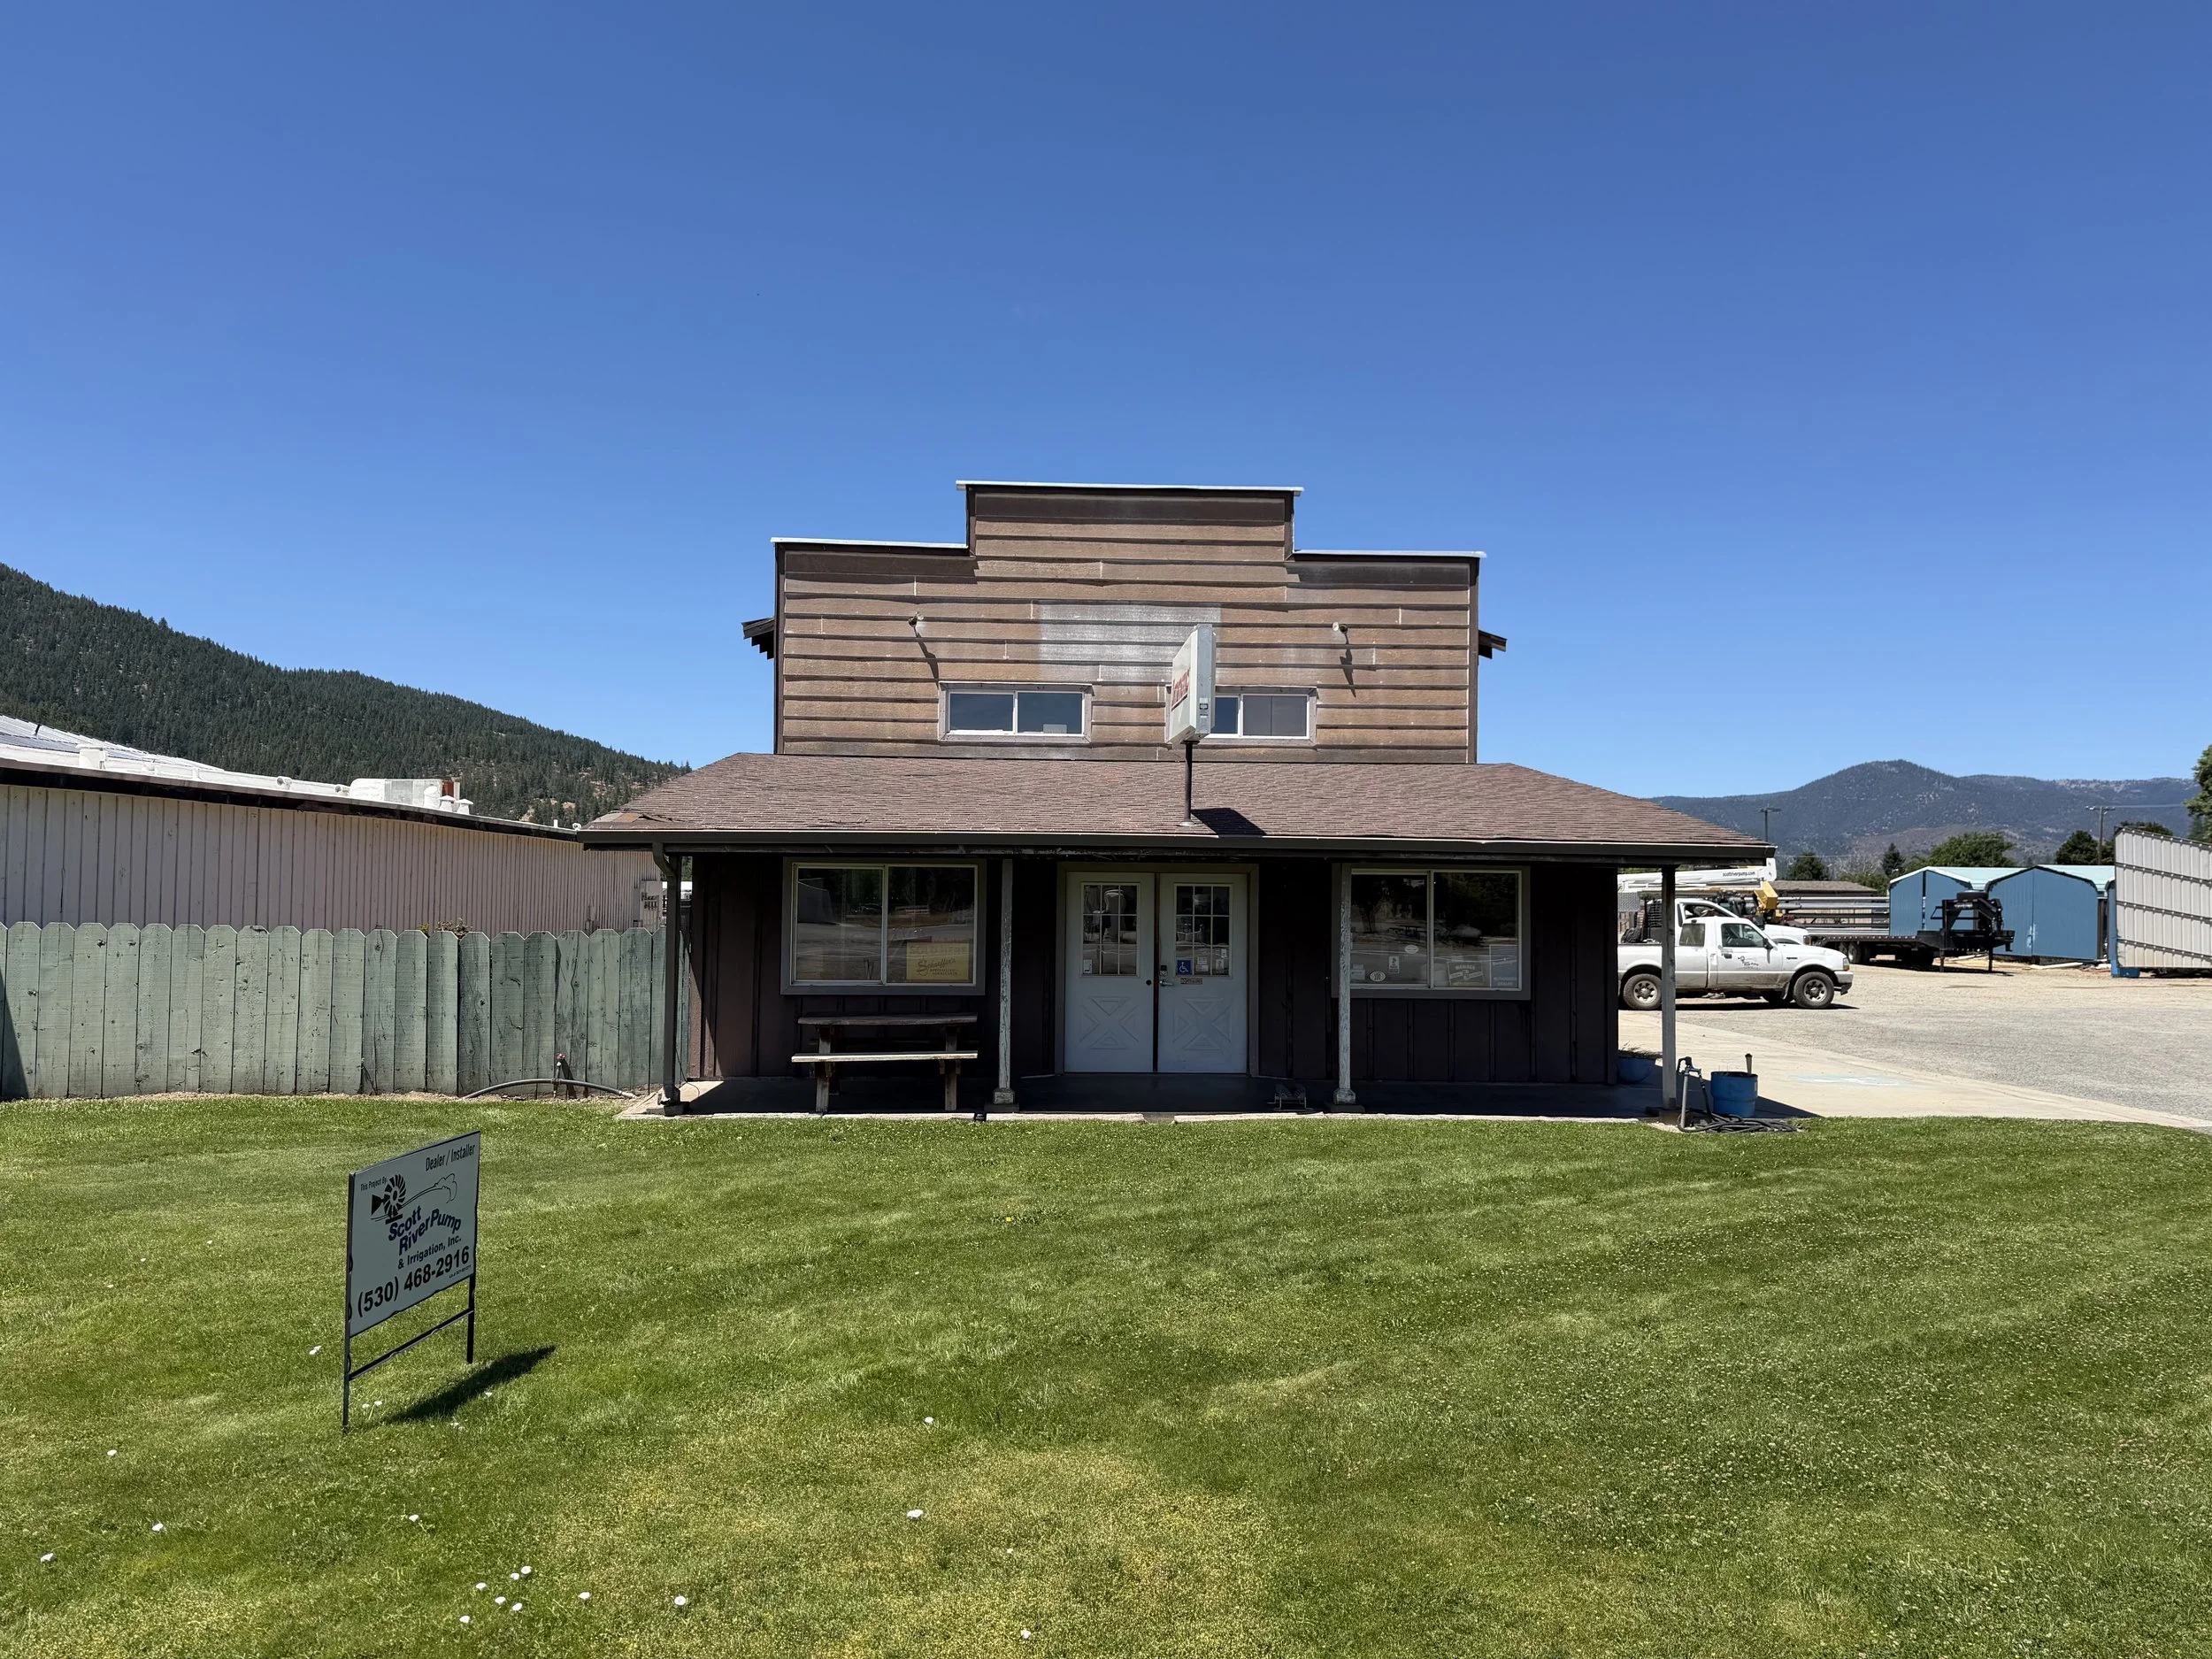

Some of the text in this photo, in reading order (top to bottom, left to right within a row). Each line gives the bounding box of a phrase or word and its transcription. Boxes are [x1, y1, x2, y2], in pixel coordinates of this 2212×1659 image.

[426, 1154, 445, 1171] Dealer
[451, 1144, 475, 1163] Installer
[369, 1178, 381, 1189] Project
[388, 1205, 421, 1241] Scott
[399, 1209, 461, 1256] River Pump
[398, 1235, 461, 1270] & Irrigation, Inc.
[357, 1245, 469, 1317] (530) 468-2916
